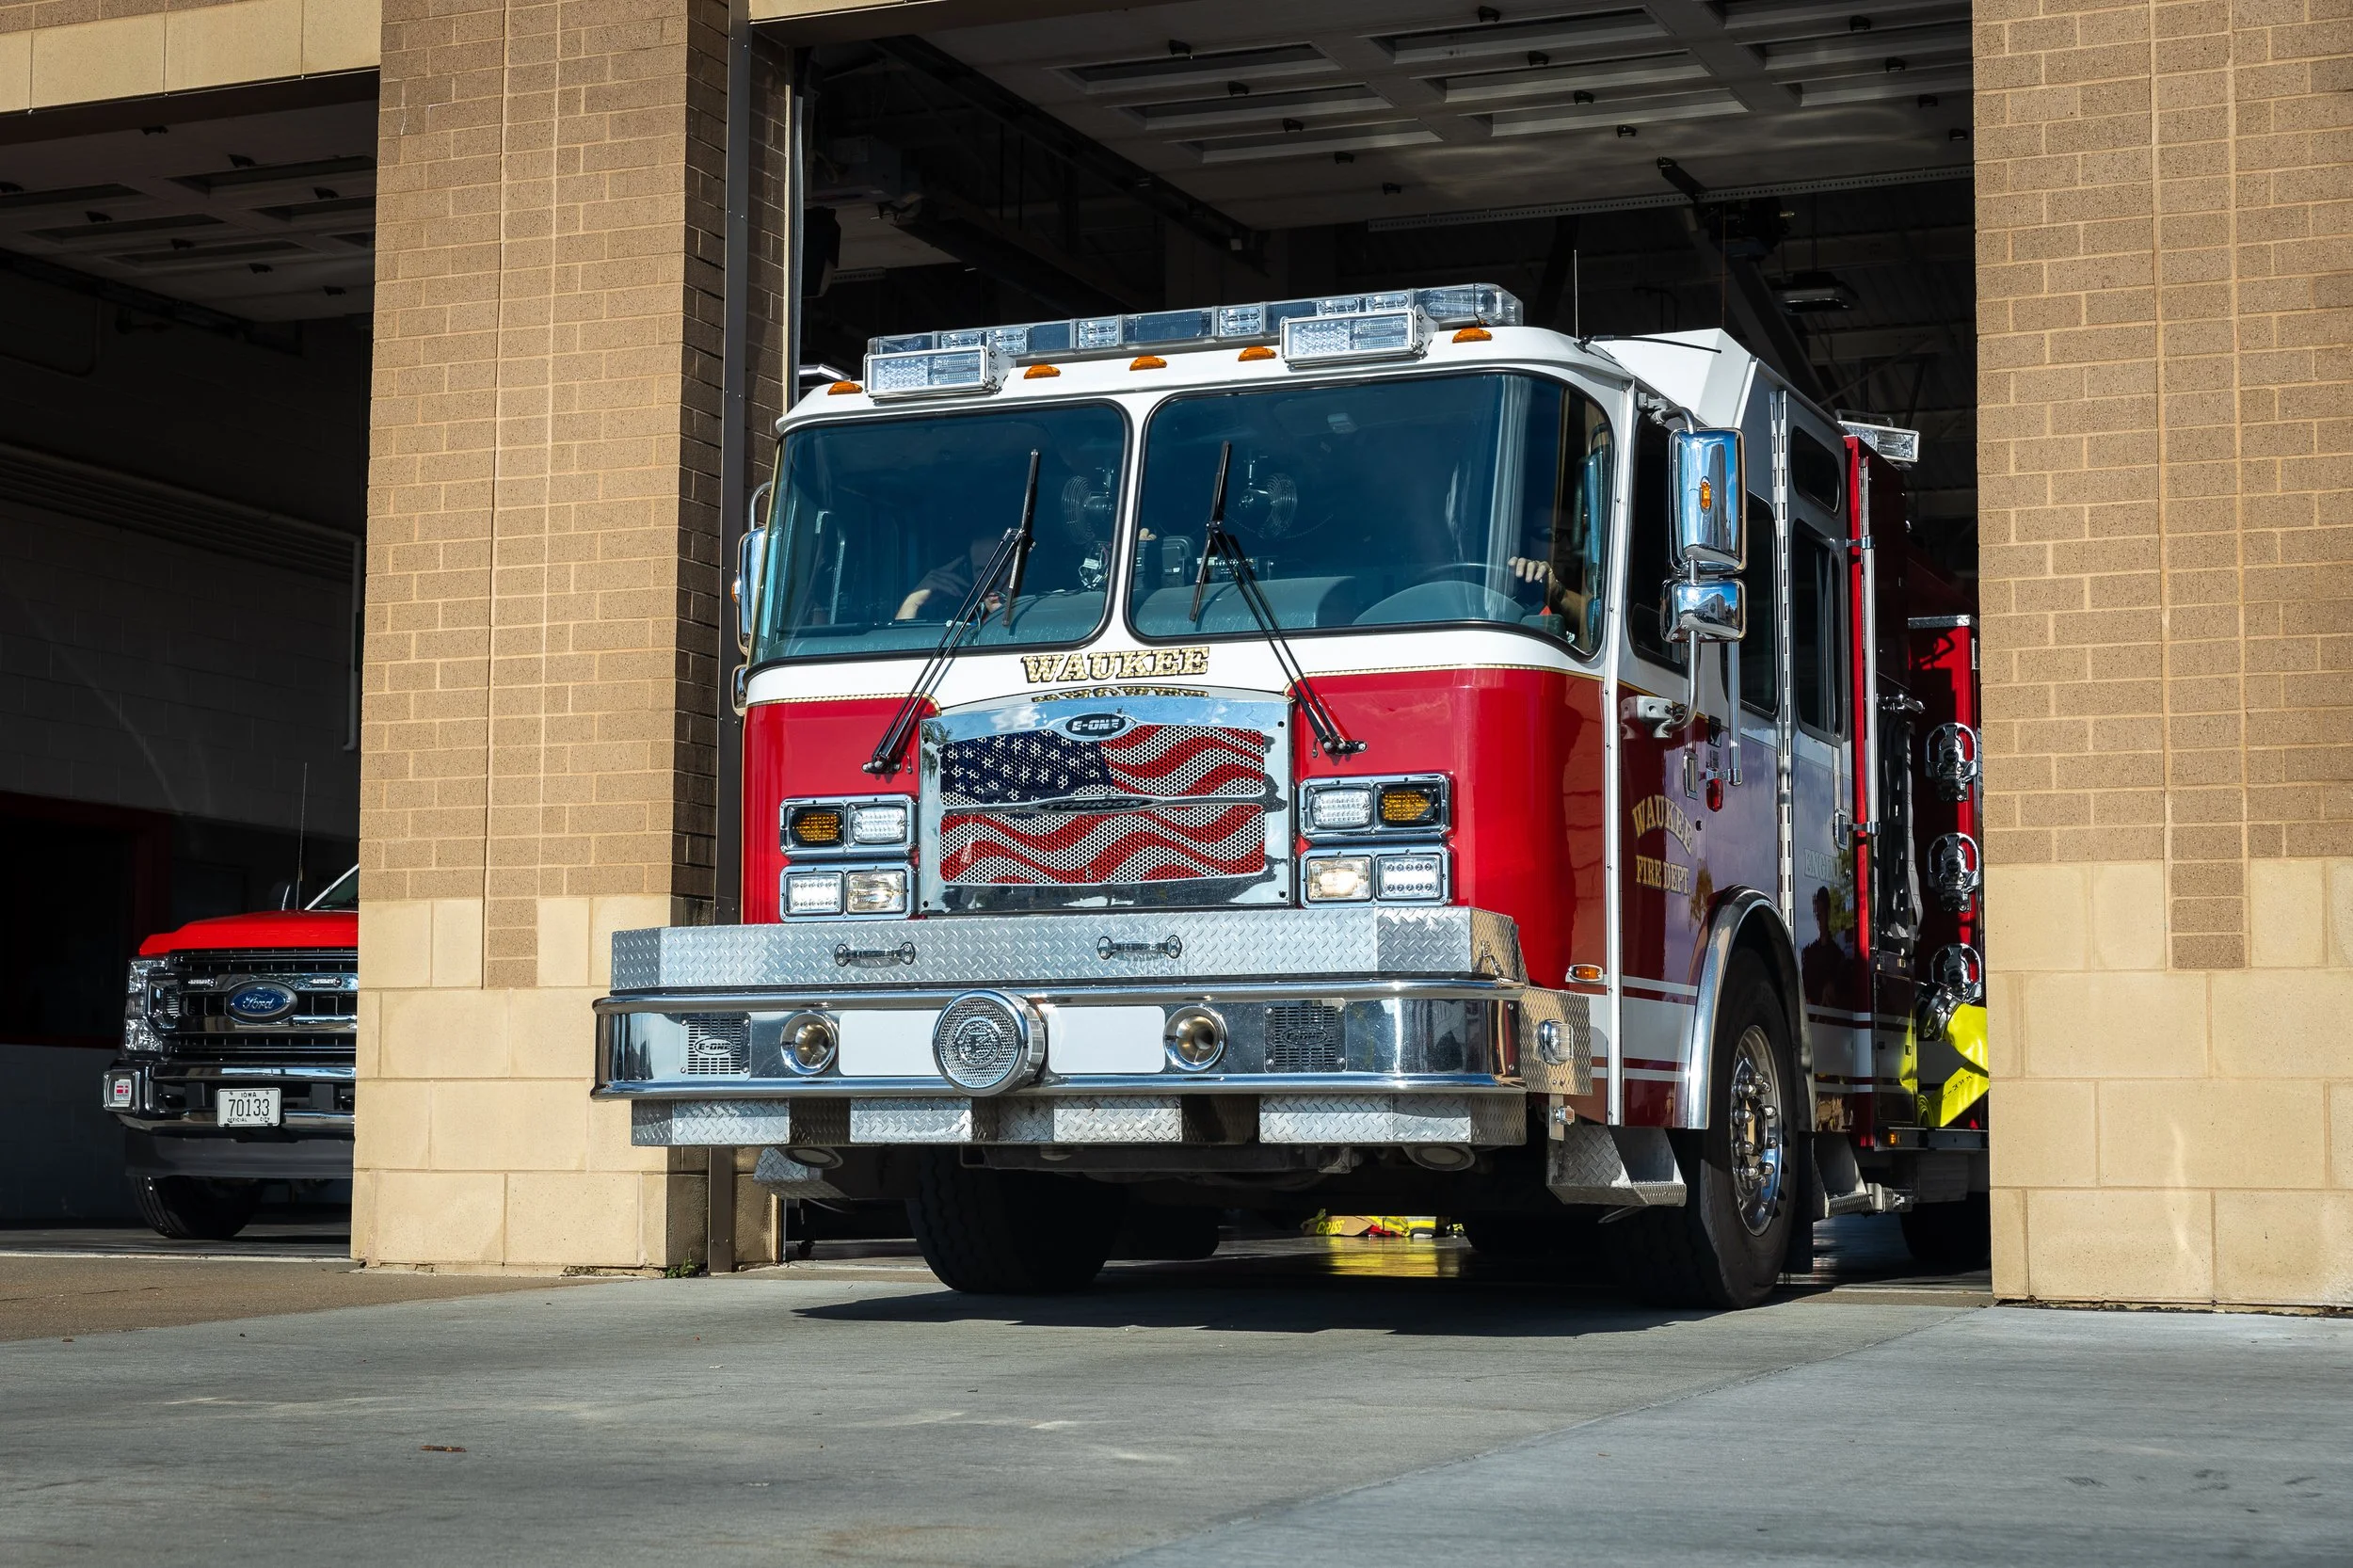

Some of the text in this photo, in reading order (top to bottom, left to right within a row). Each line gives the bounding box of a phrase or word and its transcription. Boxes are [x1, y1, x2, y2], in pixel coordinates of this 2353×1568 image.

[1020, 647, 1209, 683] WAUKEE
[1071, 718, 1120, 731] E-ONE
[1047, 799, 1144, 810] TYPHOON
[1631, 794, 1692, 856] WAUKEE
[1636, 855, 1691, 896] FIRE DEPT.
[242, 993, 275, 1009] Ford
[228, 1098, 270, 1117] 70133
[1316, 1219, 1346, 1235] CRISS
